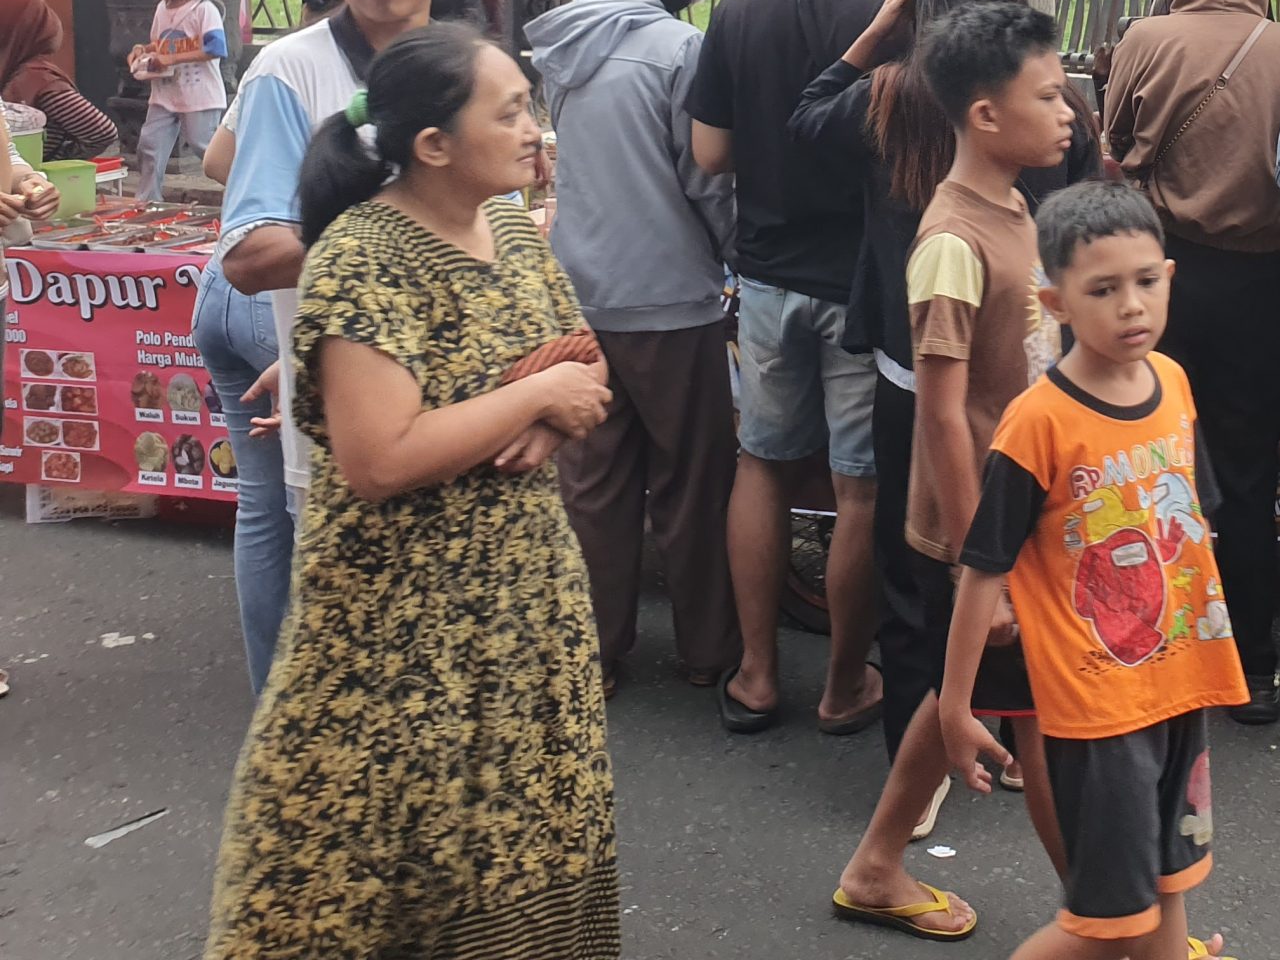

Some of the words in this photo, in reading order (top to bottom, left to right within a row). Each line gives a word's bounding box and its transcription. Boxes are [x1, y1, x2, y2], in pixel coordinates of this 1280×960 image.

[5, 258, 164, 320] Dapur
[136, 330, 161, 346] Polo
[164, 332, 196, 348] Pend
[138, 350, 171, 368] Harga
[175, 352, 204, 367] Mula
